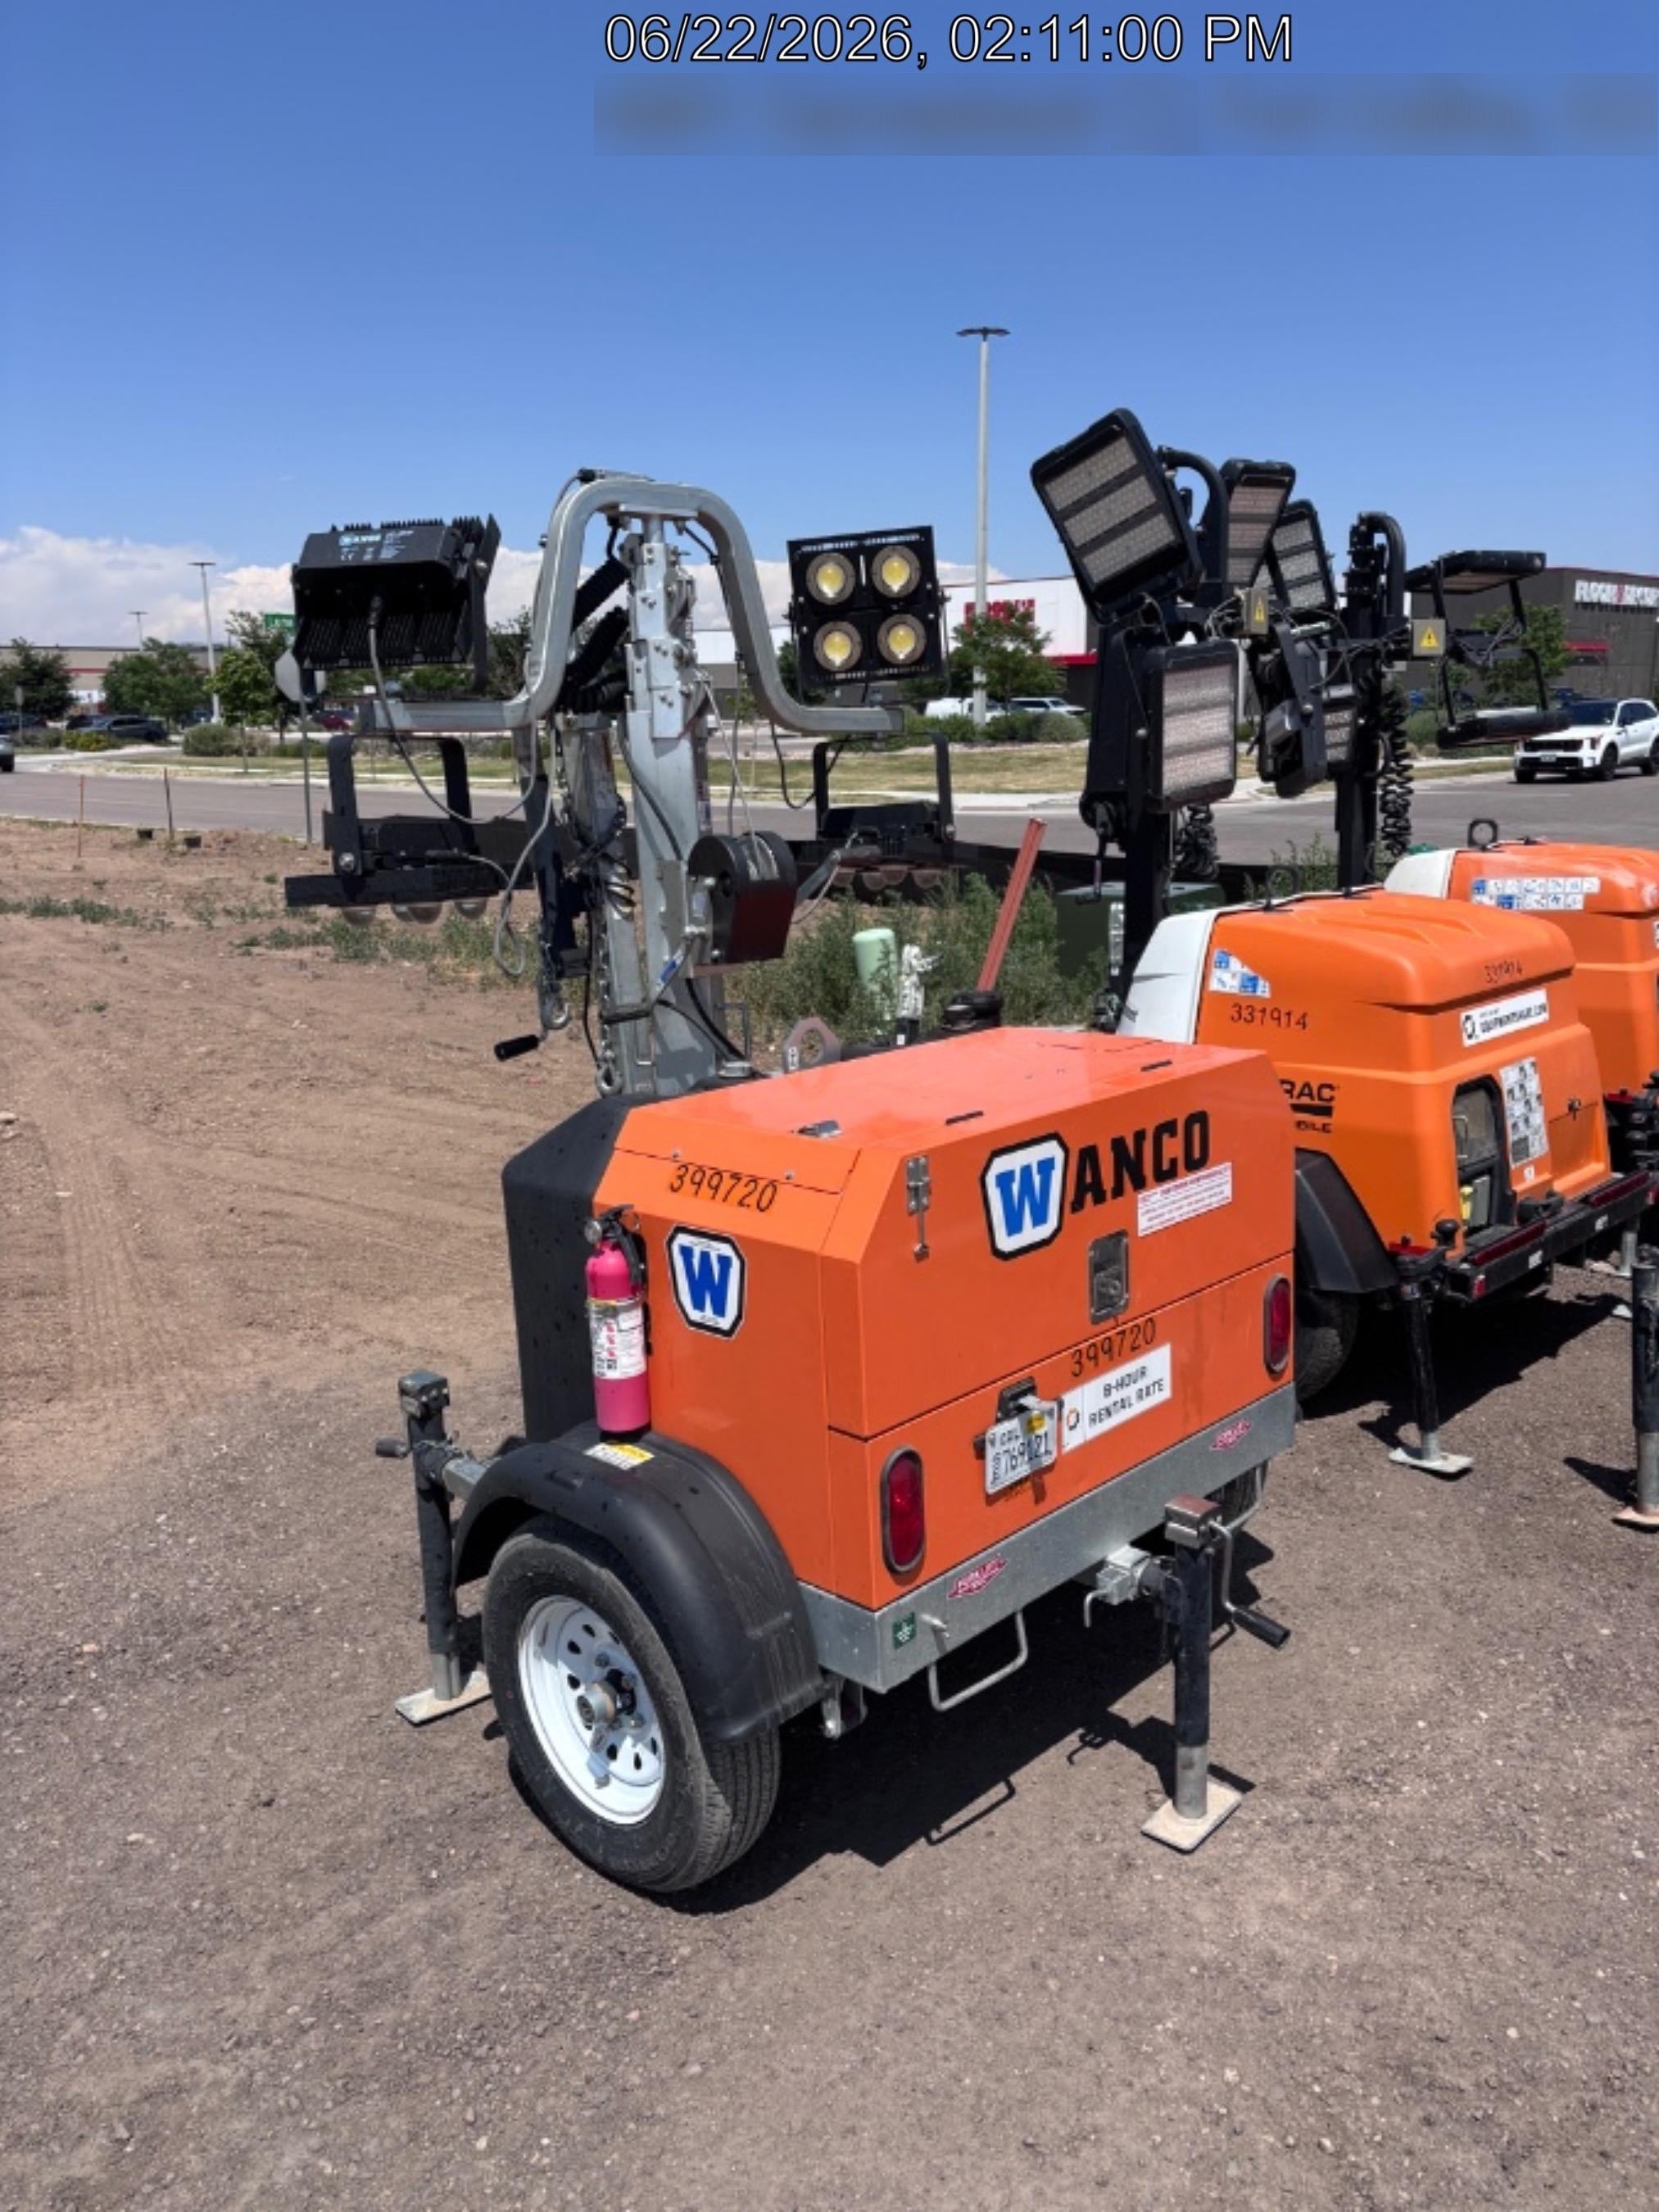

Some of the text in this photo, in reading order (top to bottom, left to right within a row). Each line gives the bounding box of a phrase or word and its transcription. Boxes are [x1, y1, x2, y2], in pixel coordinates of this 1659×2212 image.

[1231, 1002, 1308, 1031] 331914
[669, 1163, 778, 1213] 399720
[994, 1110, 1210, 1237] WANCO
[678, 1243, 733, 1319] W
[1071, 1316, 1156, 1377] 399720
[1088, 1377, 1164, 1427] RENTAL RATE
